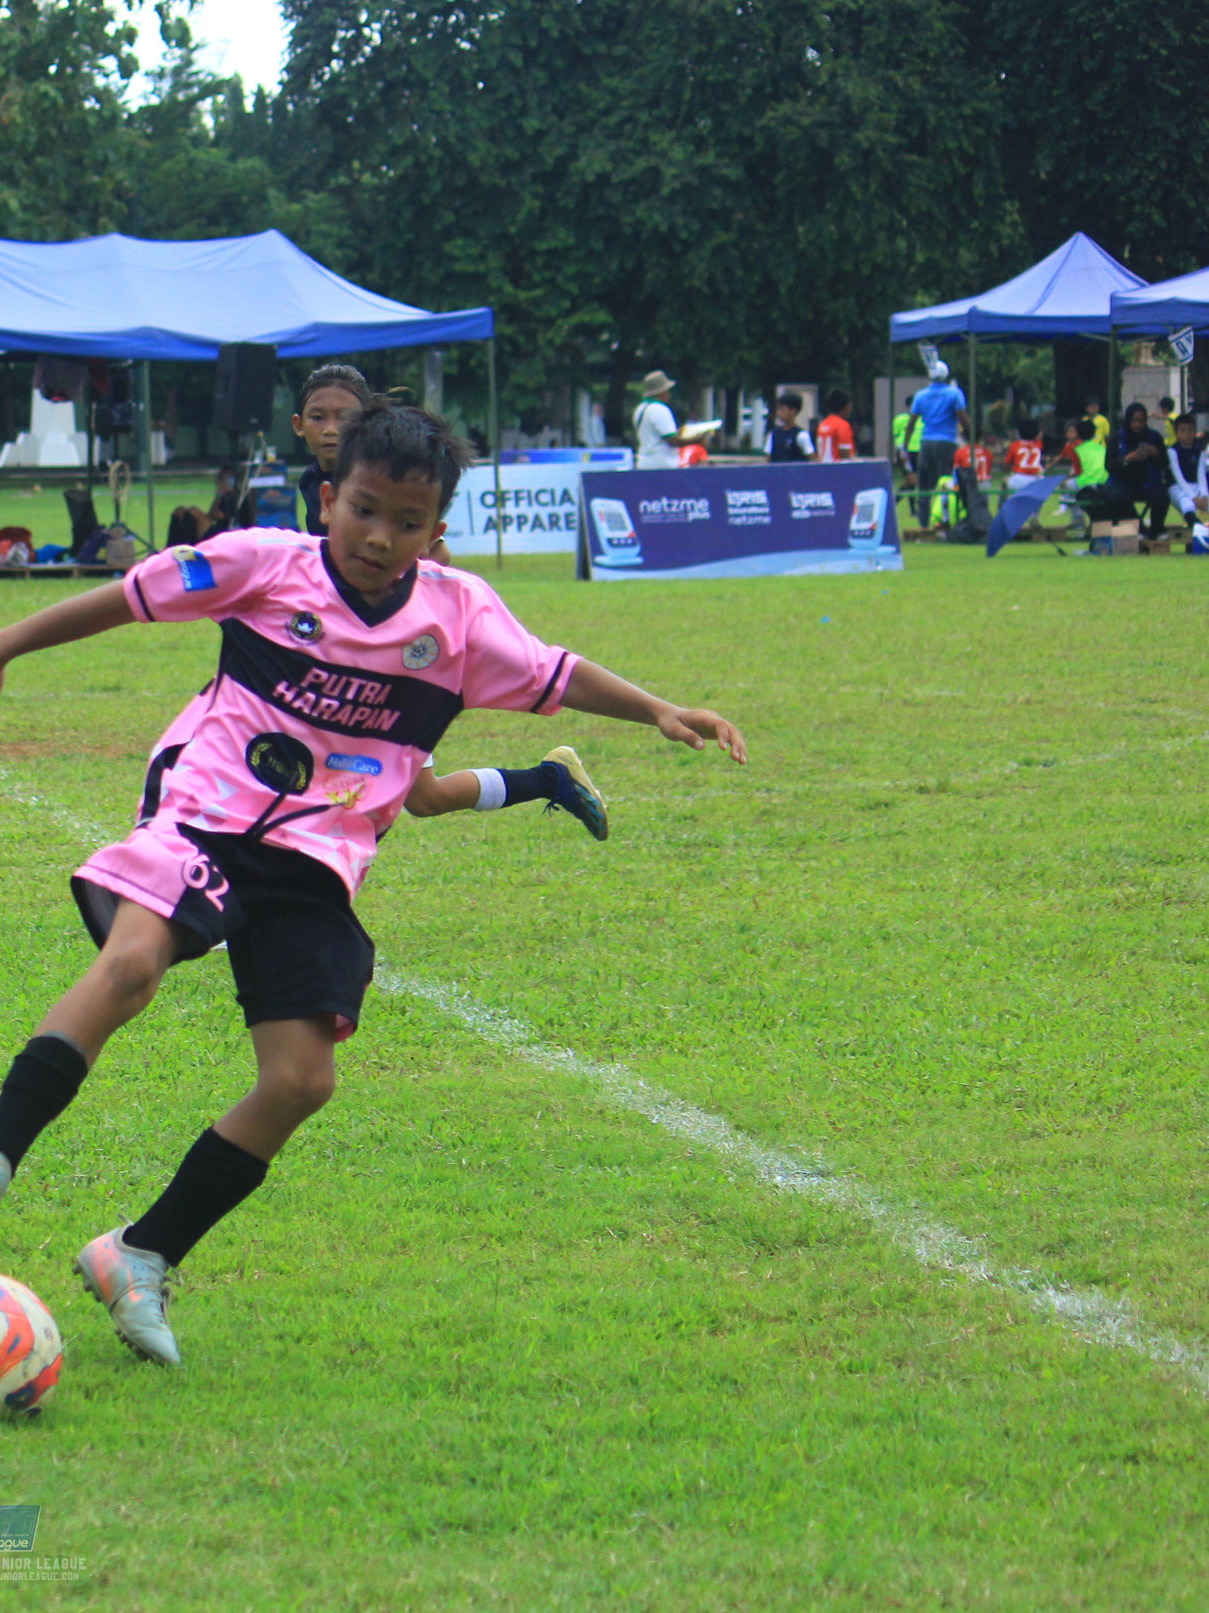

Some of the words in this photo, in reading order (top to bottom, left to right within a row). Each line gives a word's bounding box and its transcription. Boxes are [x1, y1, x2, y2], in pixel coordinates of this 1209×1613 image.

[1018, 446, 1041, 468] 22
[480, 488, 575, 508] OFFICIA
[639, 496, 709, 514] netzme
[484, 512, 577, 534] APPARE
